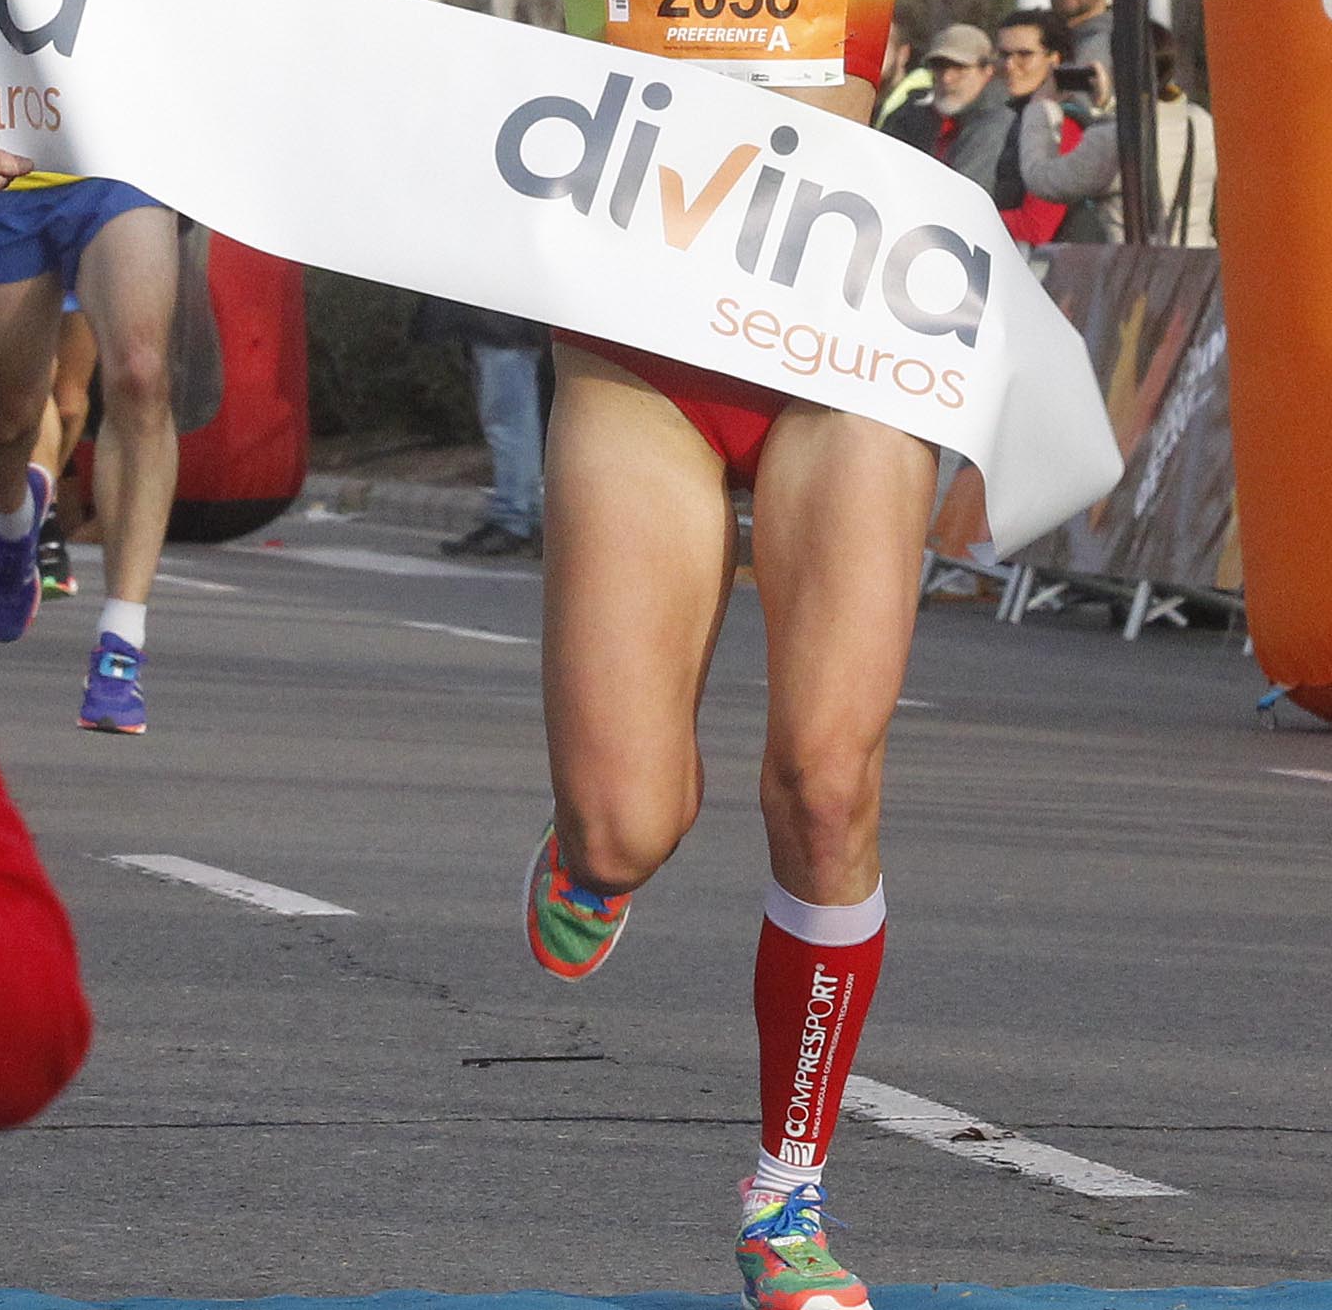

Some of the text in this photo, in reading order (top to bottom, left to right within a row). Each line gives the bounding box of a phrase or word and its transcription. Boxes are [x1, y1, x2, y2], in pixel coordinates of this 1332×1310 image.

[666, 25, 792, 52] PREFERENTE A
[494, 71, 992, 349] divina
[709, 296, 966, 410] seguros
[784, 970, 839, 1138] COMPRESSPORT
